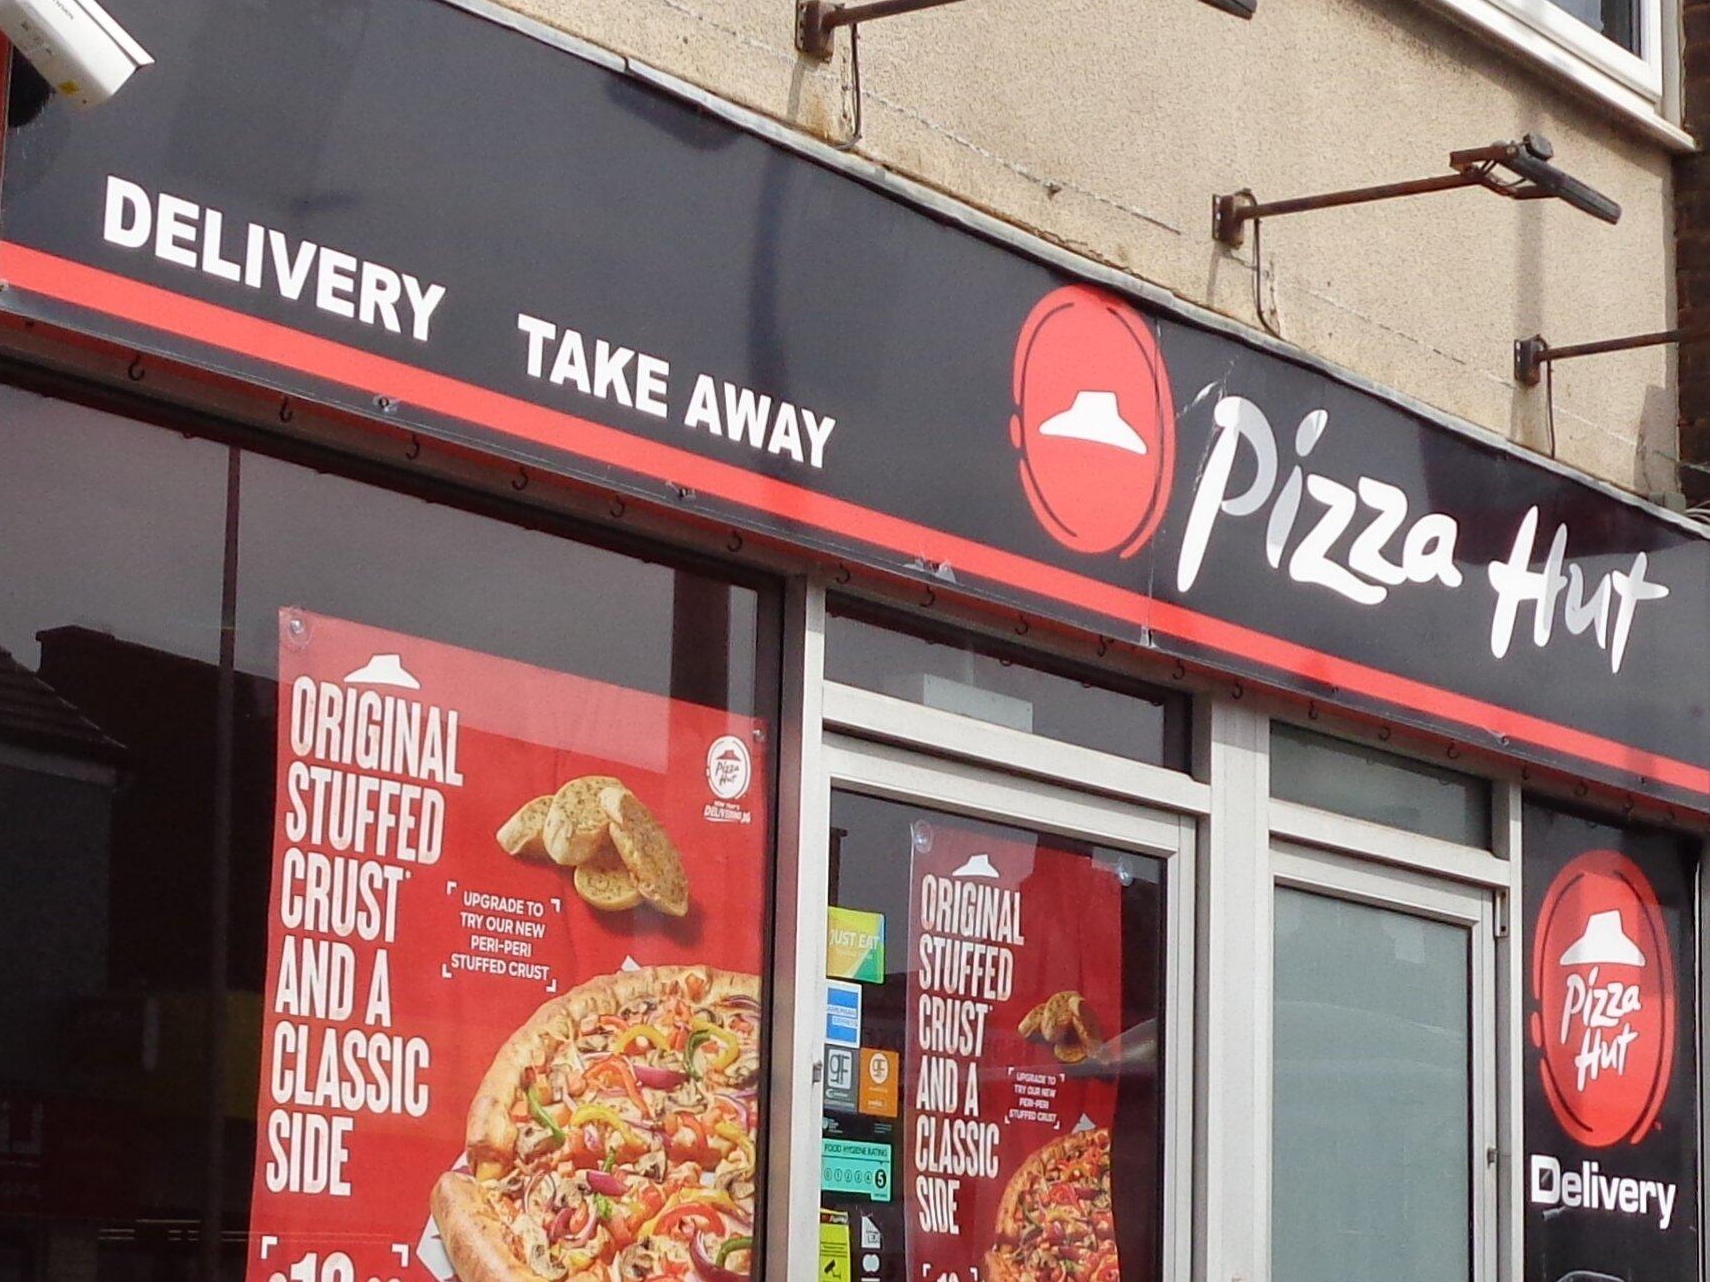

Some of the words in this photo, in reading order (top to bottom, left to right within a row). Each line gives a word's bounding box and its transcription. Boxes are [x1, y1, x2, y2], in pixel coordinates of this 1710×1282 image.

[102, 174, 447, 342] DELIVERY
[518, 314, 670, 418] TAKE
[685, 373, 837, 469] AWAY
[1176, 394, 1464, 606] Pizza
[1488, 504, 1670, 675] Hut
[290, 675, 464, 787] ORIGINAL
[285, 762, 444, 865] STUFFED
[460, 911, 484, 929] TRY
[486, 916, 514, 935] OUR
[515, 920, 546, 939] NEW
[463, 891, 524, 915] UPGRADE
[526, 901, 544, 917] TO
[828, 929, 858, 947] JUST
[858, 933, 880, 950] EAT
[921, 873, 1025, 946] ORIGINAL
[274, 935, 349, 1023] AND
[364, 958, 392, 1027] A
[451, 953, 507, 975] STUFFED
[508, 961, 550, 981] CRUST
[471, 935, 532, 958] PERI-PERI
[919, 934, 1014, 1002] STUFFED
[1559, 966, 1642, 1045] Pizza
[271, 1021, 431, 1119] CLASSIC
[916, 1054, 958, 1115] AND
[964, 1060, 980, 1118] A
[1574, 1023, 1638, 1092] Hut
[265, 1109, 352, 1196] SIDE
[824, 1143, 842, 1153] FOOD
[915, 1116, 1000, 1179] CLASSIC
[916, 1175, 959, 1234] SIDE
[1530, 1154, 1677, 1230] Delivery
